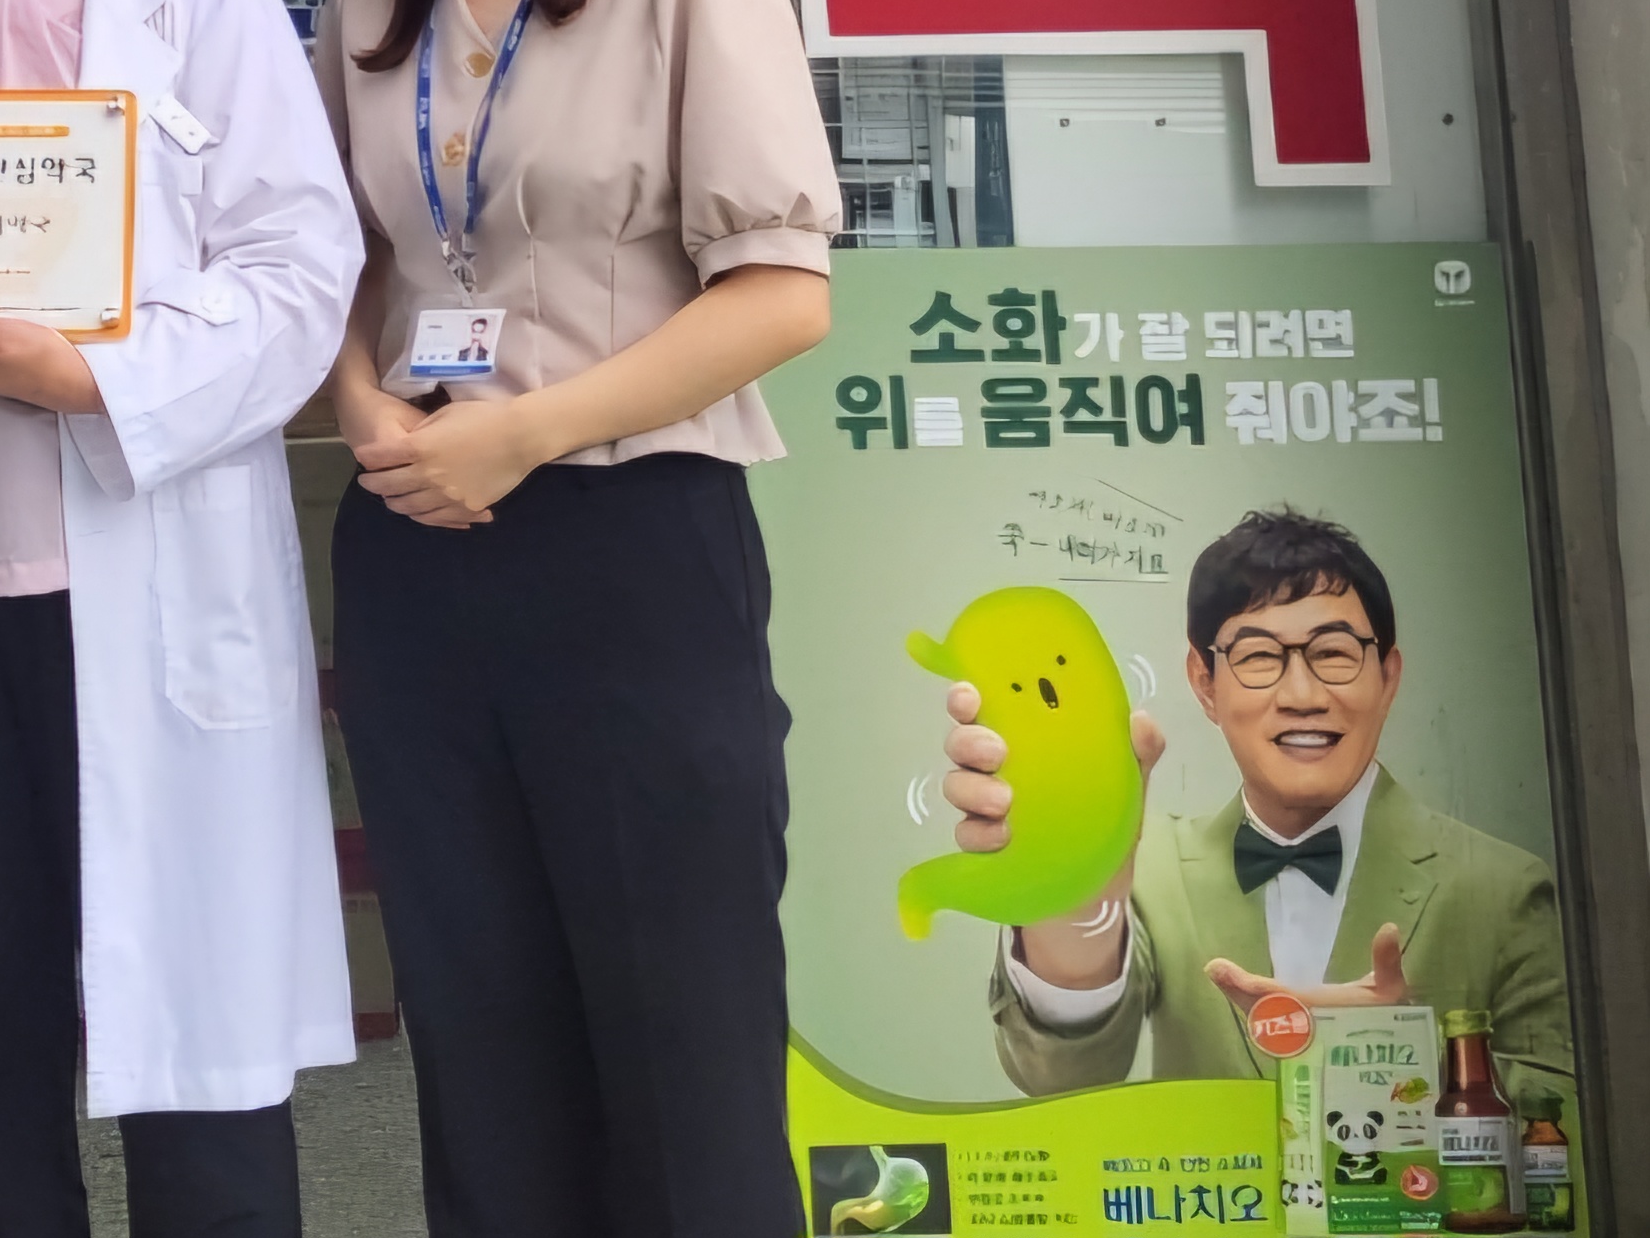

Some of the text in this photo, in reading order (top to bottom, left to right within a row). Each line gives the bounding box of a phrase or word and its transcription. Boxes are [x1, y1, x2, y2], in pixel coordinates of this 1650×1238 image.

[909, 287, 1355, 365] 소화가 잘 되려면
[979, 372, 1207, 450] 움직여
[1225, 377, 1444, 445] 줘야죠!
[1102, 1183, 1270, 1225] 베나치오
